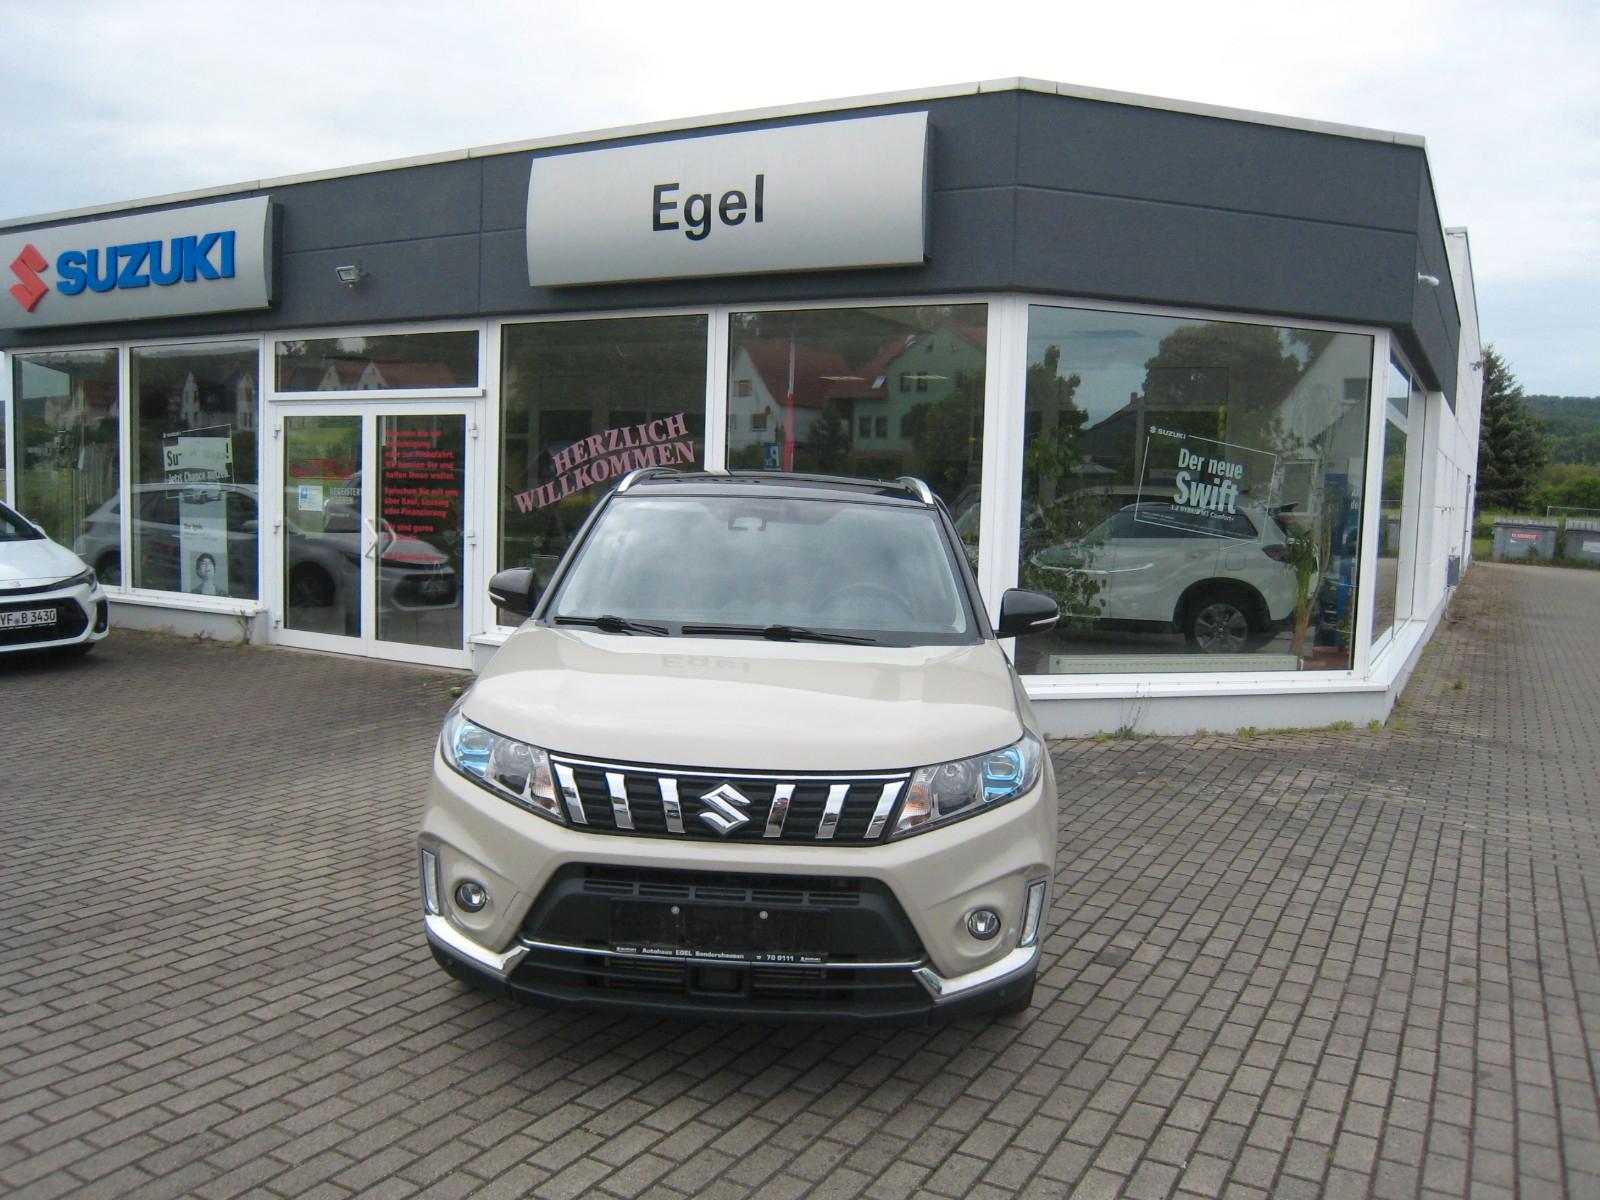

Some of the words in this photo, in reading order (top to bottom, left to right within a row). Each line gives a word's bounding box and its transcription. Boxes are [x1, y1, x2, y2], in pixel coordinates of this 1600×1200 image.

[653, 174, 764, 241] Egel
[56, 230, 236, 296] SUZUKI
[551, 412, 689, 475] HERZLICH
[1158, 428, 1187, 439] SUZUKI
[513, 440, 697, 514] WILLKOMMEN
[1178, 447, 1205, 471] Der
[1208, 458, 1243, 479] neue
[1173, 470, 1239, 515] Swift
[22, 612, 28, 624] B
[31, 610, 55, 623] 3430
